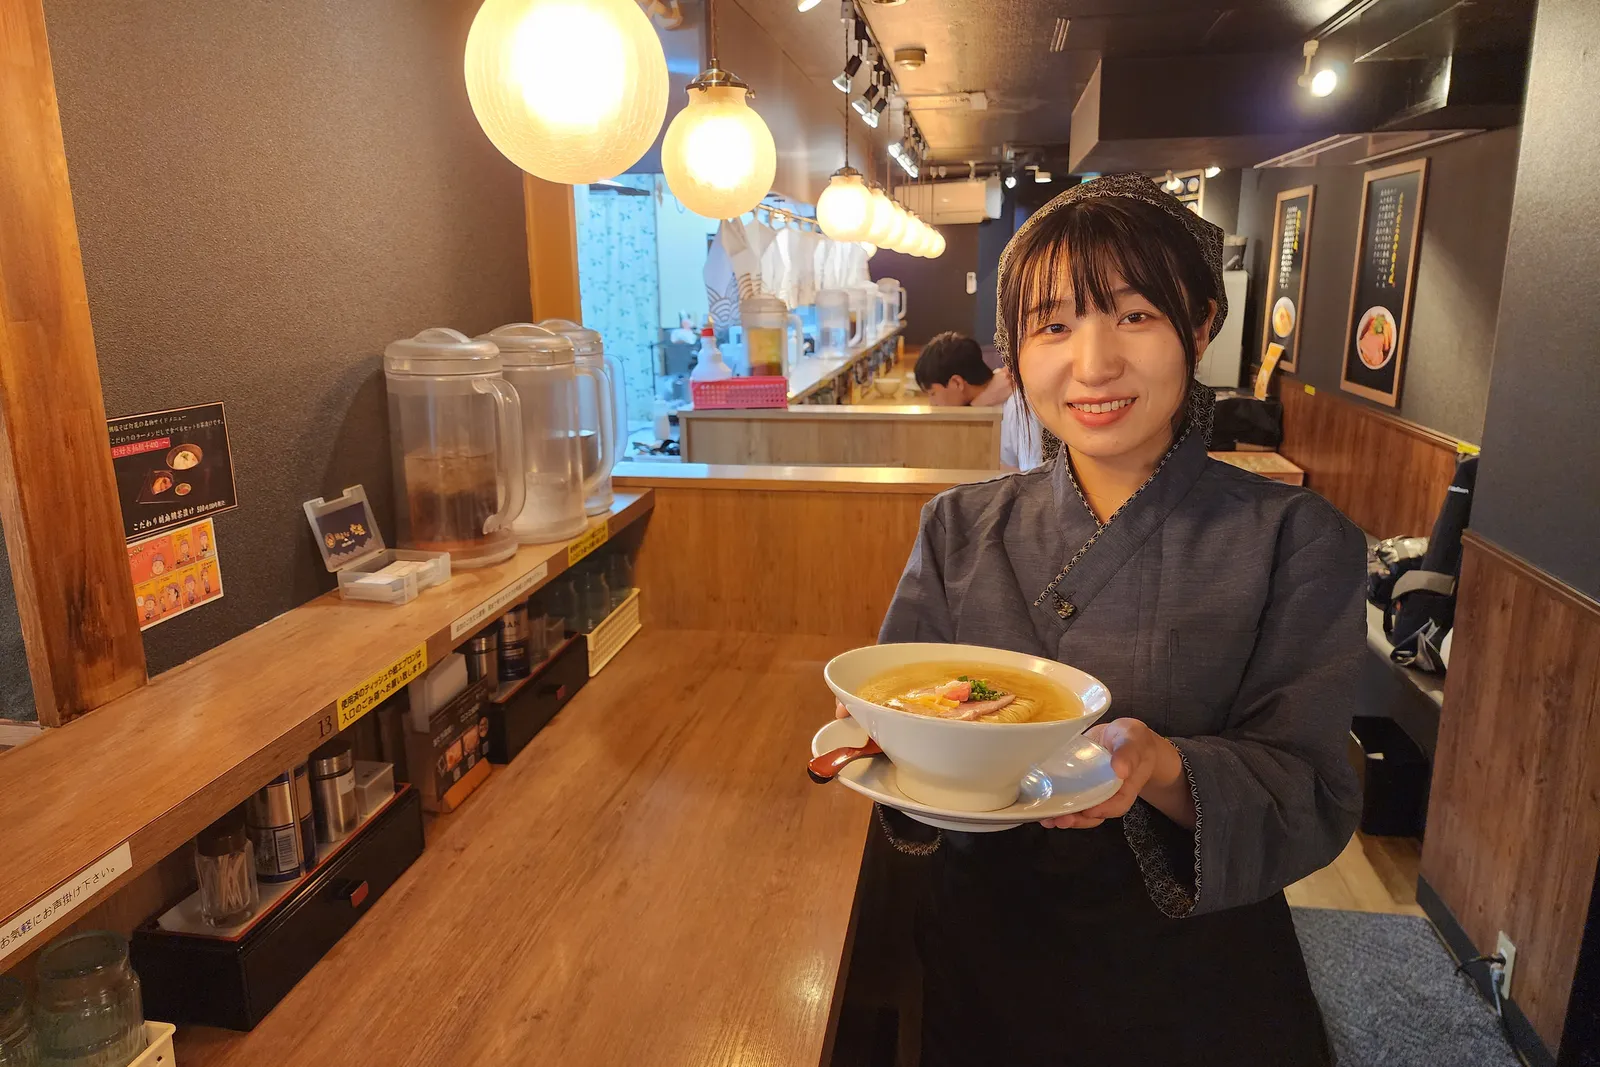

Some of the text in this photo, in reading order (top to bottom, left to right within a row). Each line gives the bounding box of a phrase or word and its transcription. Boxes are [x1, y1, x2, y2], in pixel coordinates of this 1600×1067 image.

[341, 650, 422, 710] 使用済のティッシュや紙エプロンは
[317, 715, 333, 739] 13
[0, 866, 115, 950] お気軽にお声掛け下さい。
